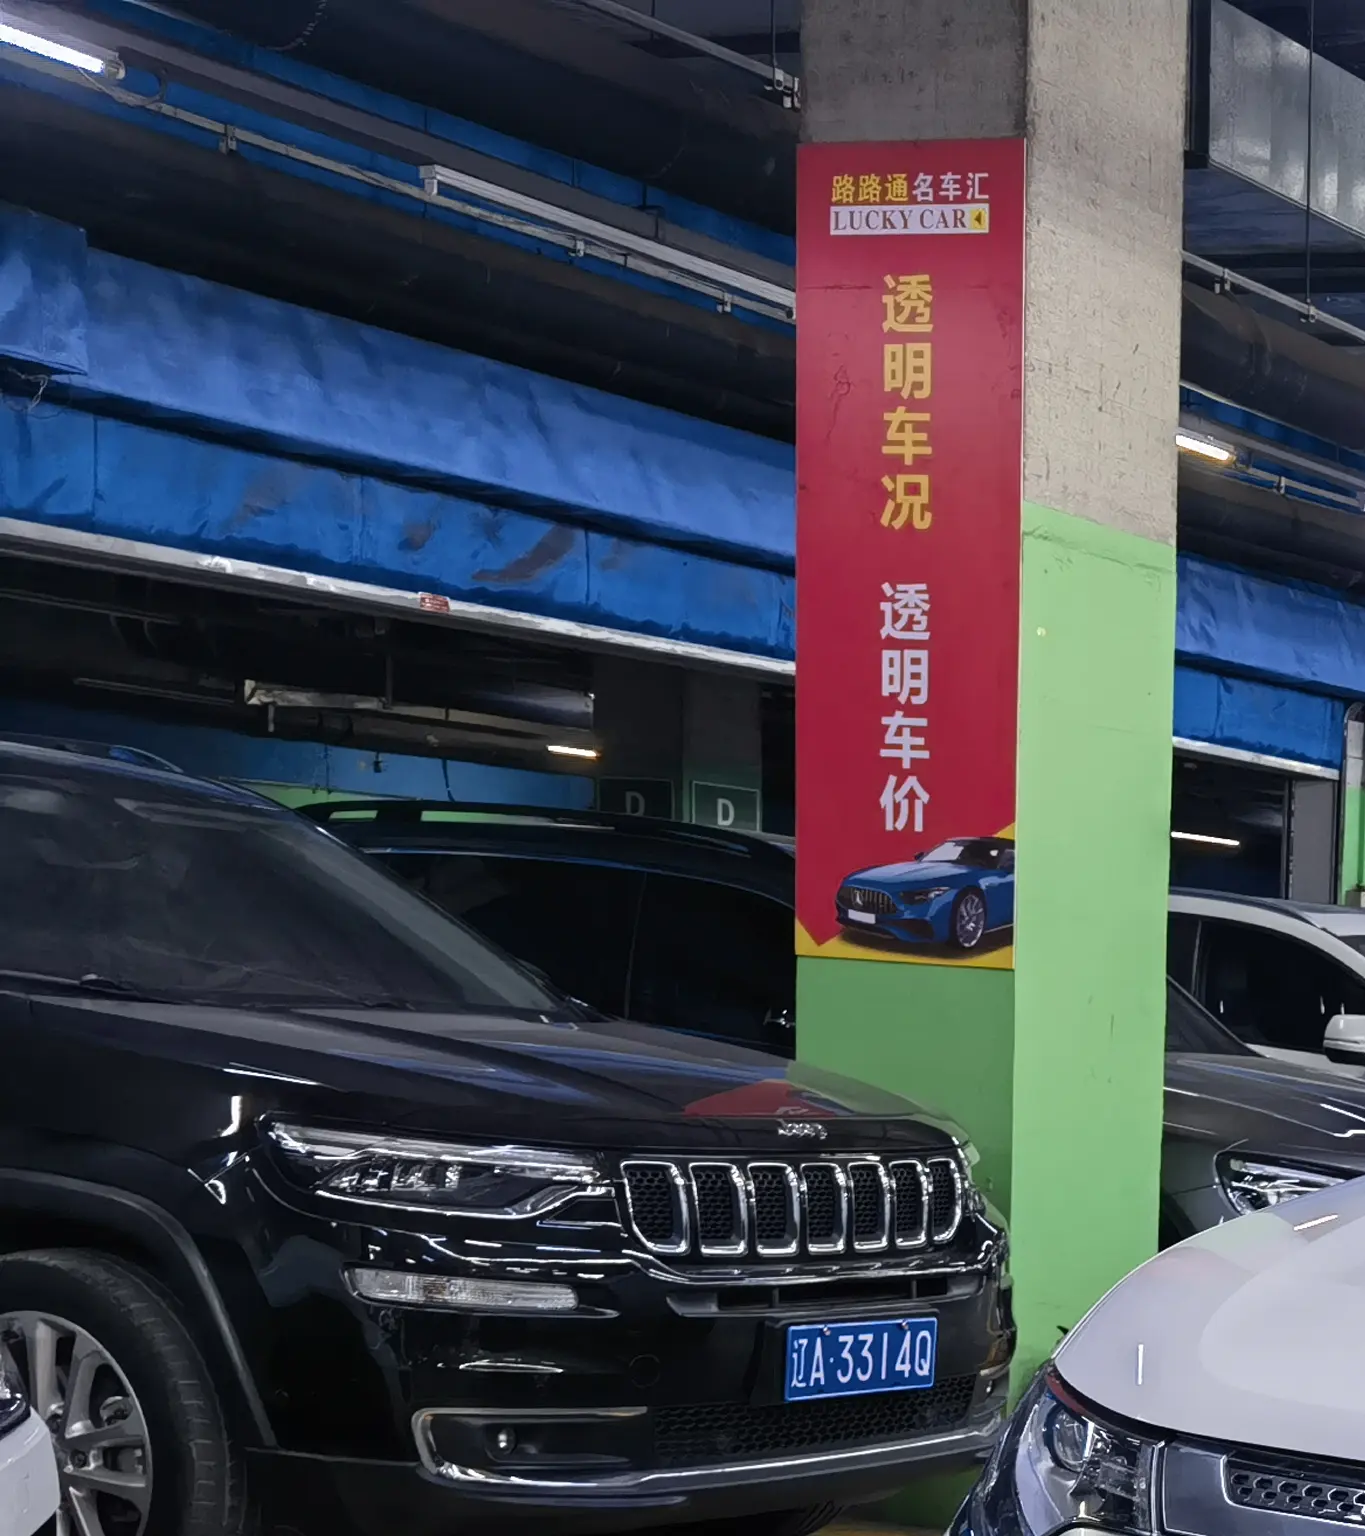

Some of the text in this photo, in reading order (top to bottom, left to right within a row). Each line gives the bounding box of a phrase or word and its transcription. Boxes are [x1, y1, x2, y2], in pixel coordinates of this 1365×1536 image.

[831, 172, 989, 204] 路路通名车汇
[833, 208, 967, 231] LUCKY CAR
[879, 274, 933, 832] 透明车况 透明车价
[717, 798, 735, 826] D
